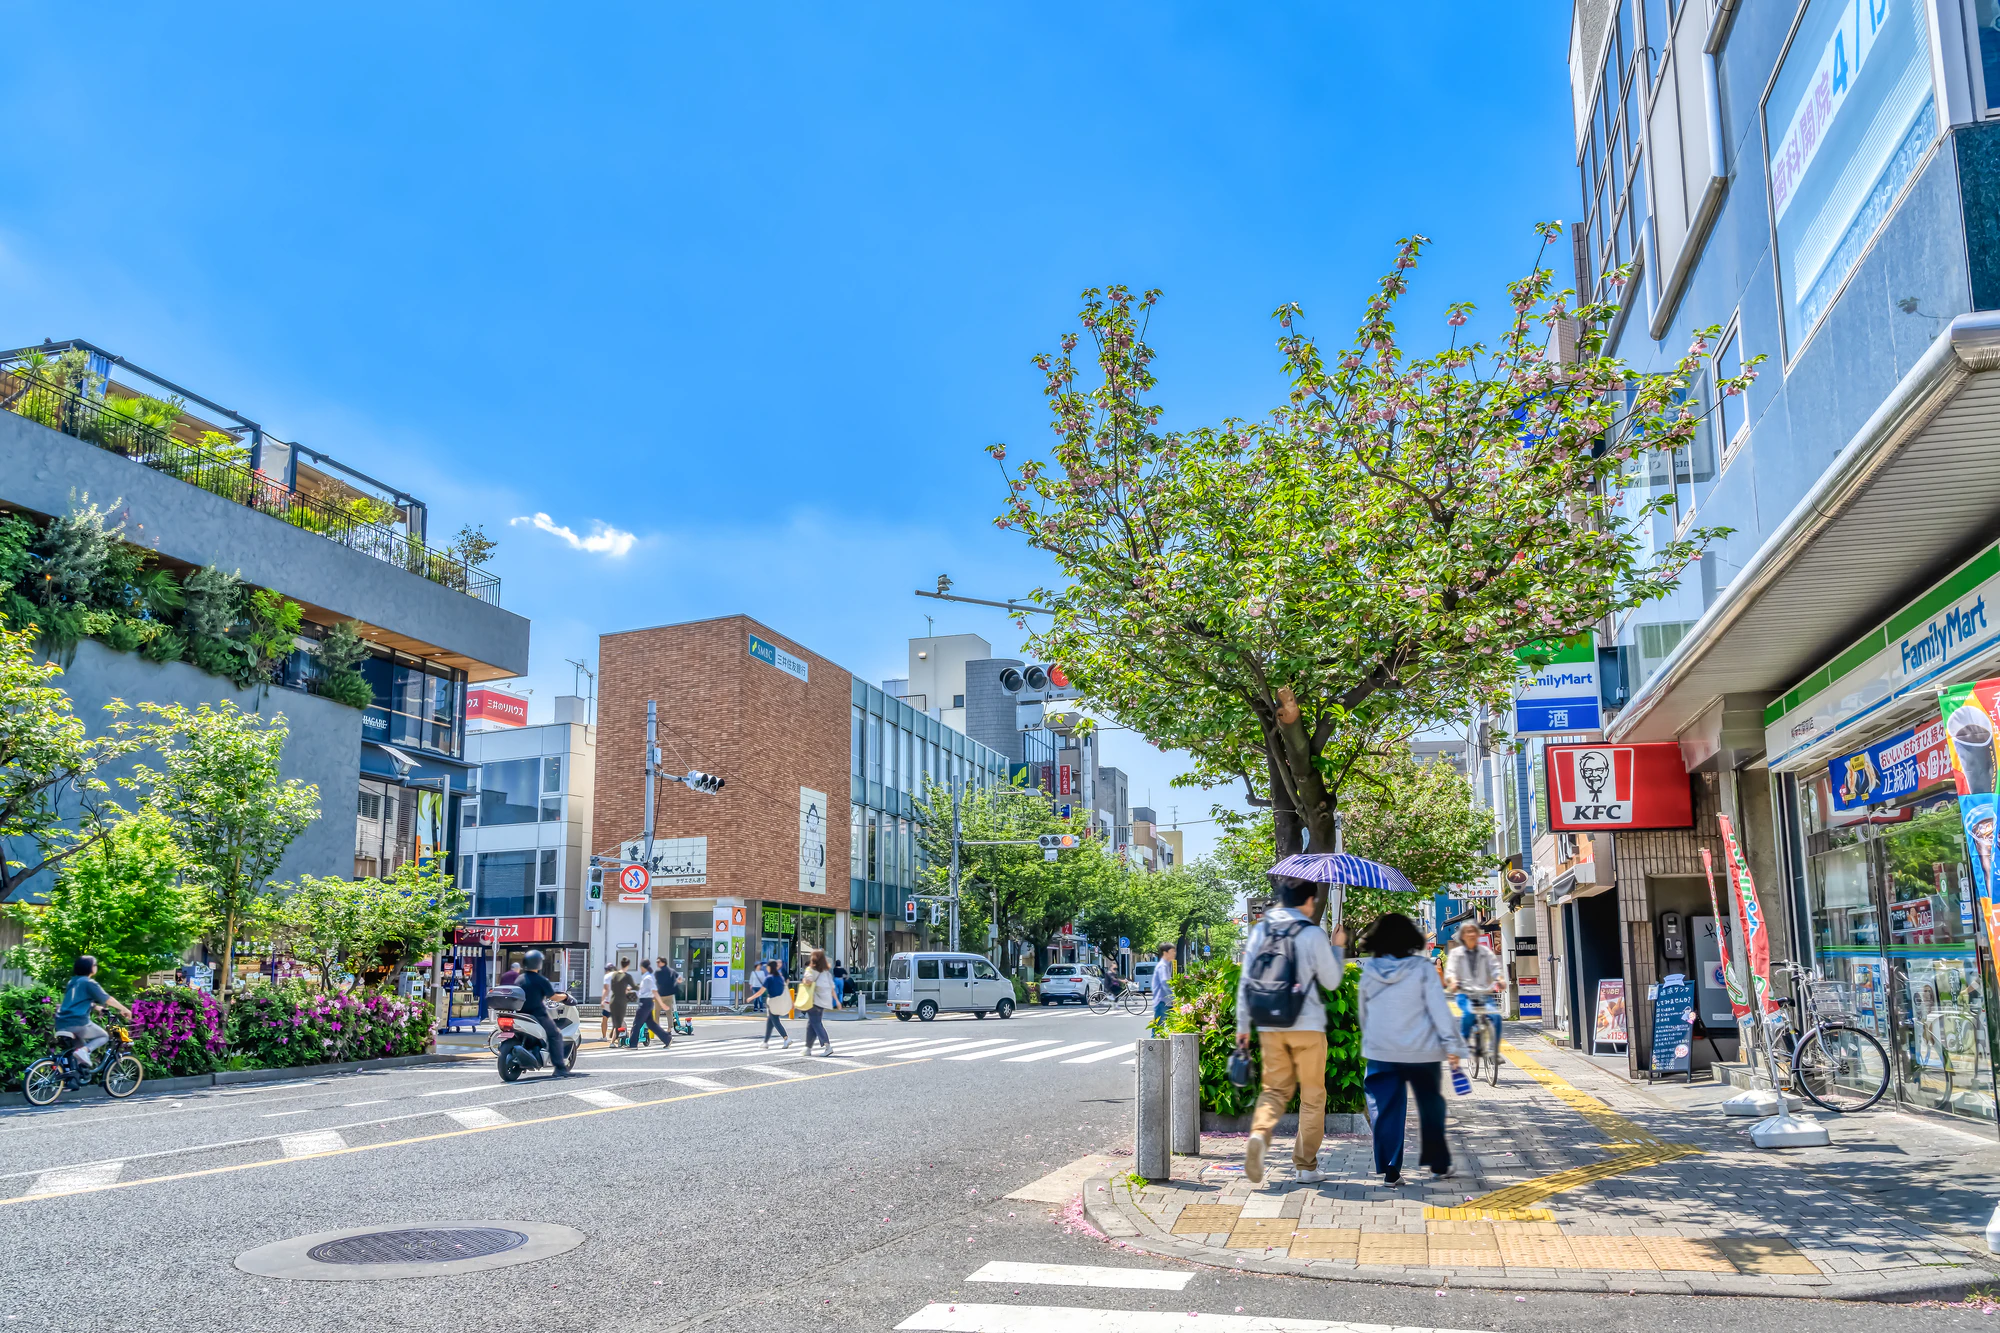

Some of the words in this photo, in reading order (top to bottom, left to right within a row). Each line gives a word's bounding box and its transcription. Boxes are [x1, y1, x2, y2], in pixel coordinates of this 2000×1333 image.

[1772, 70, 1832, 215] 歯科開院
[1901, 594, 1988, 675] FamilyMart
[757, 645, 773, 661] SMBC
[777, 654, 806, 677] 三井住友銀行
[1519, 673, 1593, 688] FmilyMart
[487, 699, 524, 717] 三井のリハウス
[1548, 710, 1569, 728] 酒
[1880, 724, 1947, 767] おいしいおむすび、続々
[1882, 760, 1916, 795] 正統派
[1572, 804, 1622, 821] KFC
